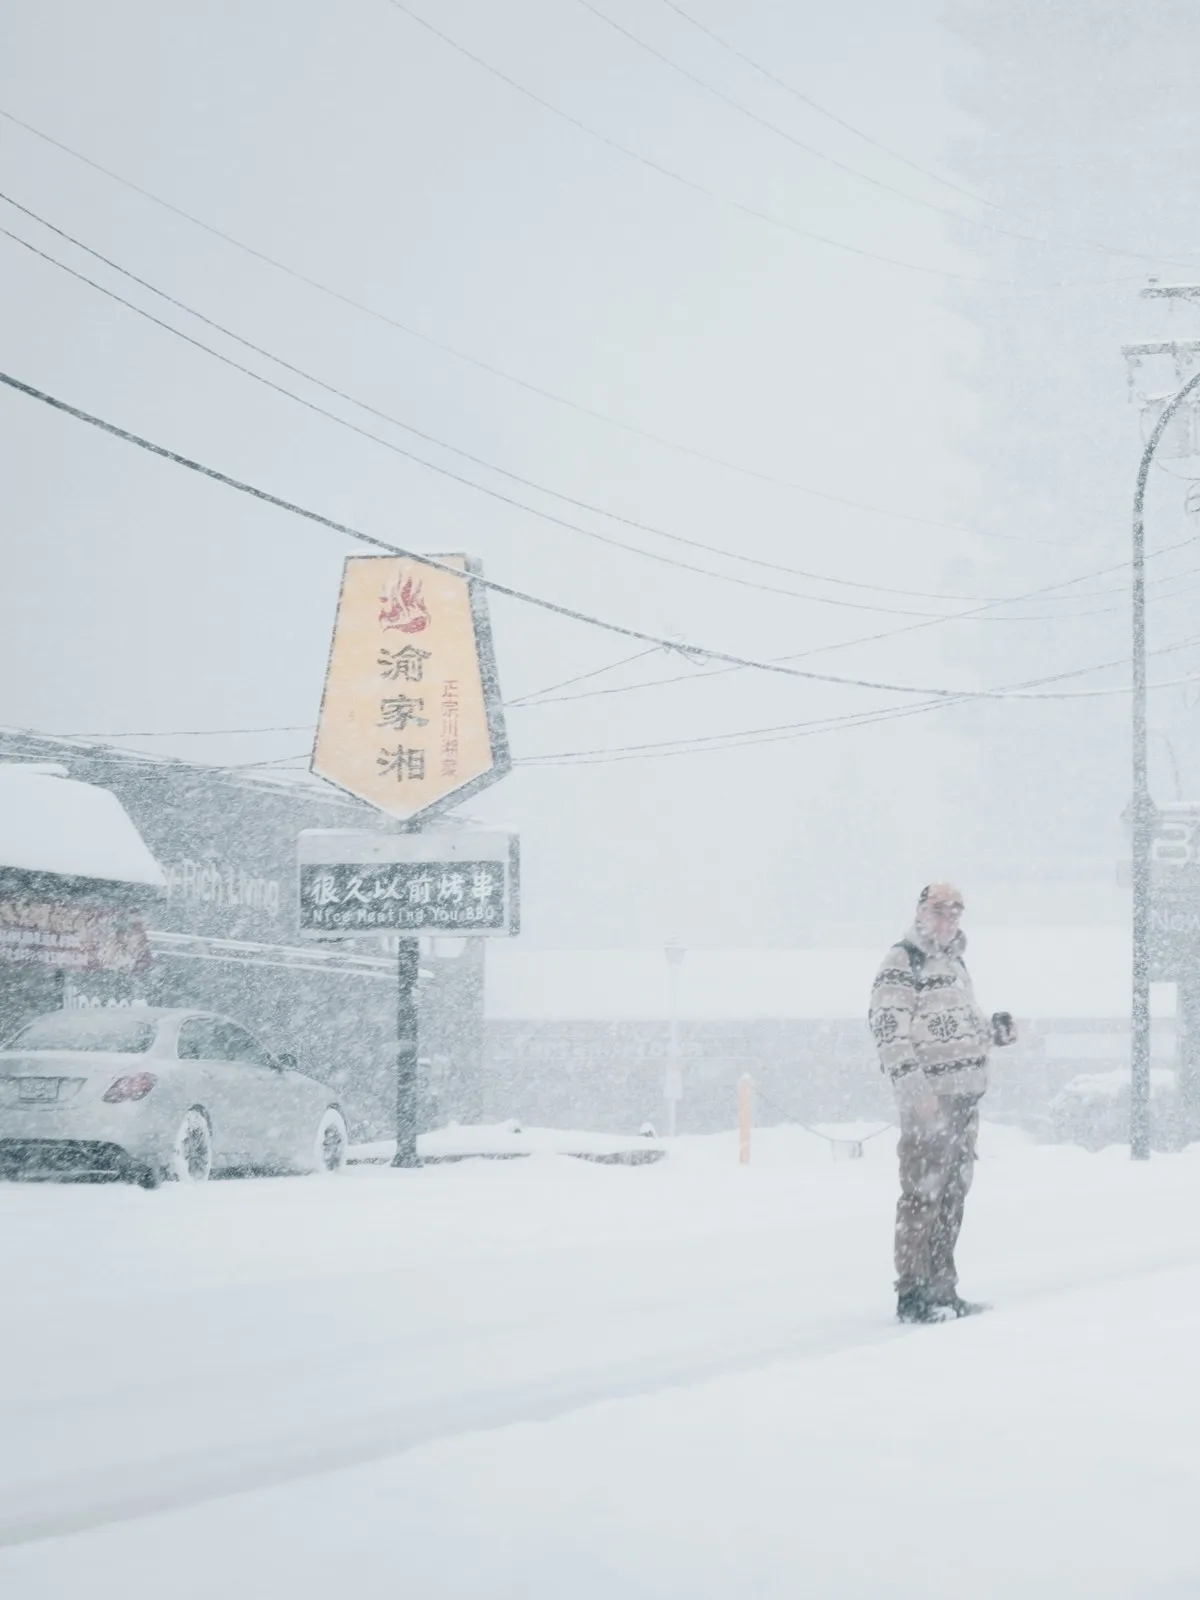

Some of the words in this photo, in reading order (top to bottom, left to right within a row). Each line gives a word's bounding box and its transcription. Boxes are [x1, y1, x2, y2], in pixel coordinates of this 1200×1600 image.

[376, 644, 432, 782] 渝家湘
[311, 871, 494, 904] 很久以前烤串
[313, 908, 351, 923] Nice
[432, 906, 458, 922] You
[465, 906, 495, 921] BBQ
